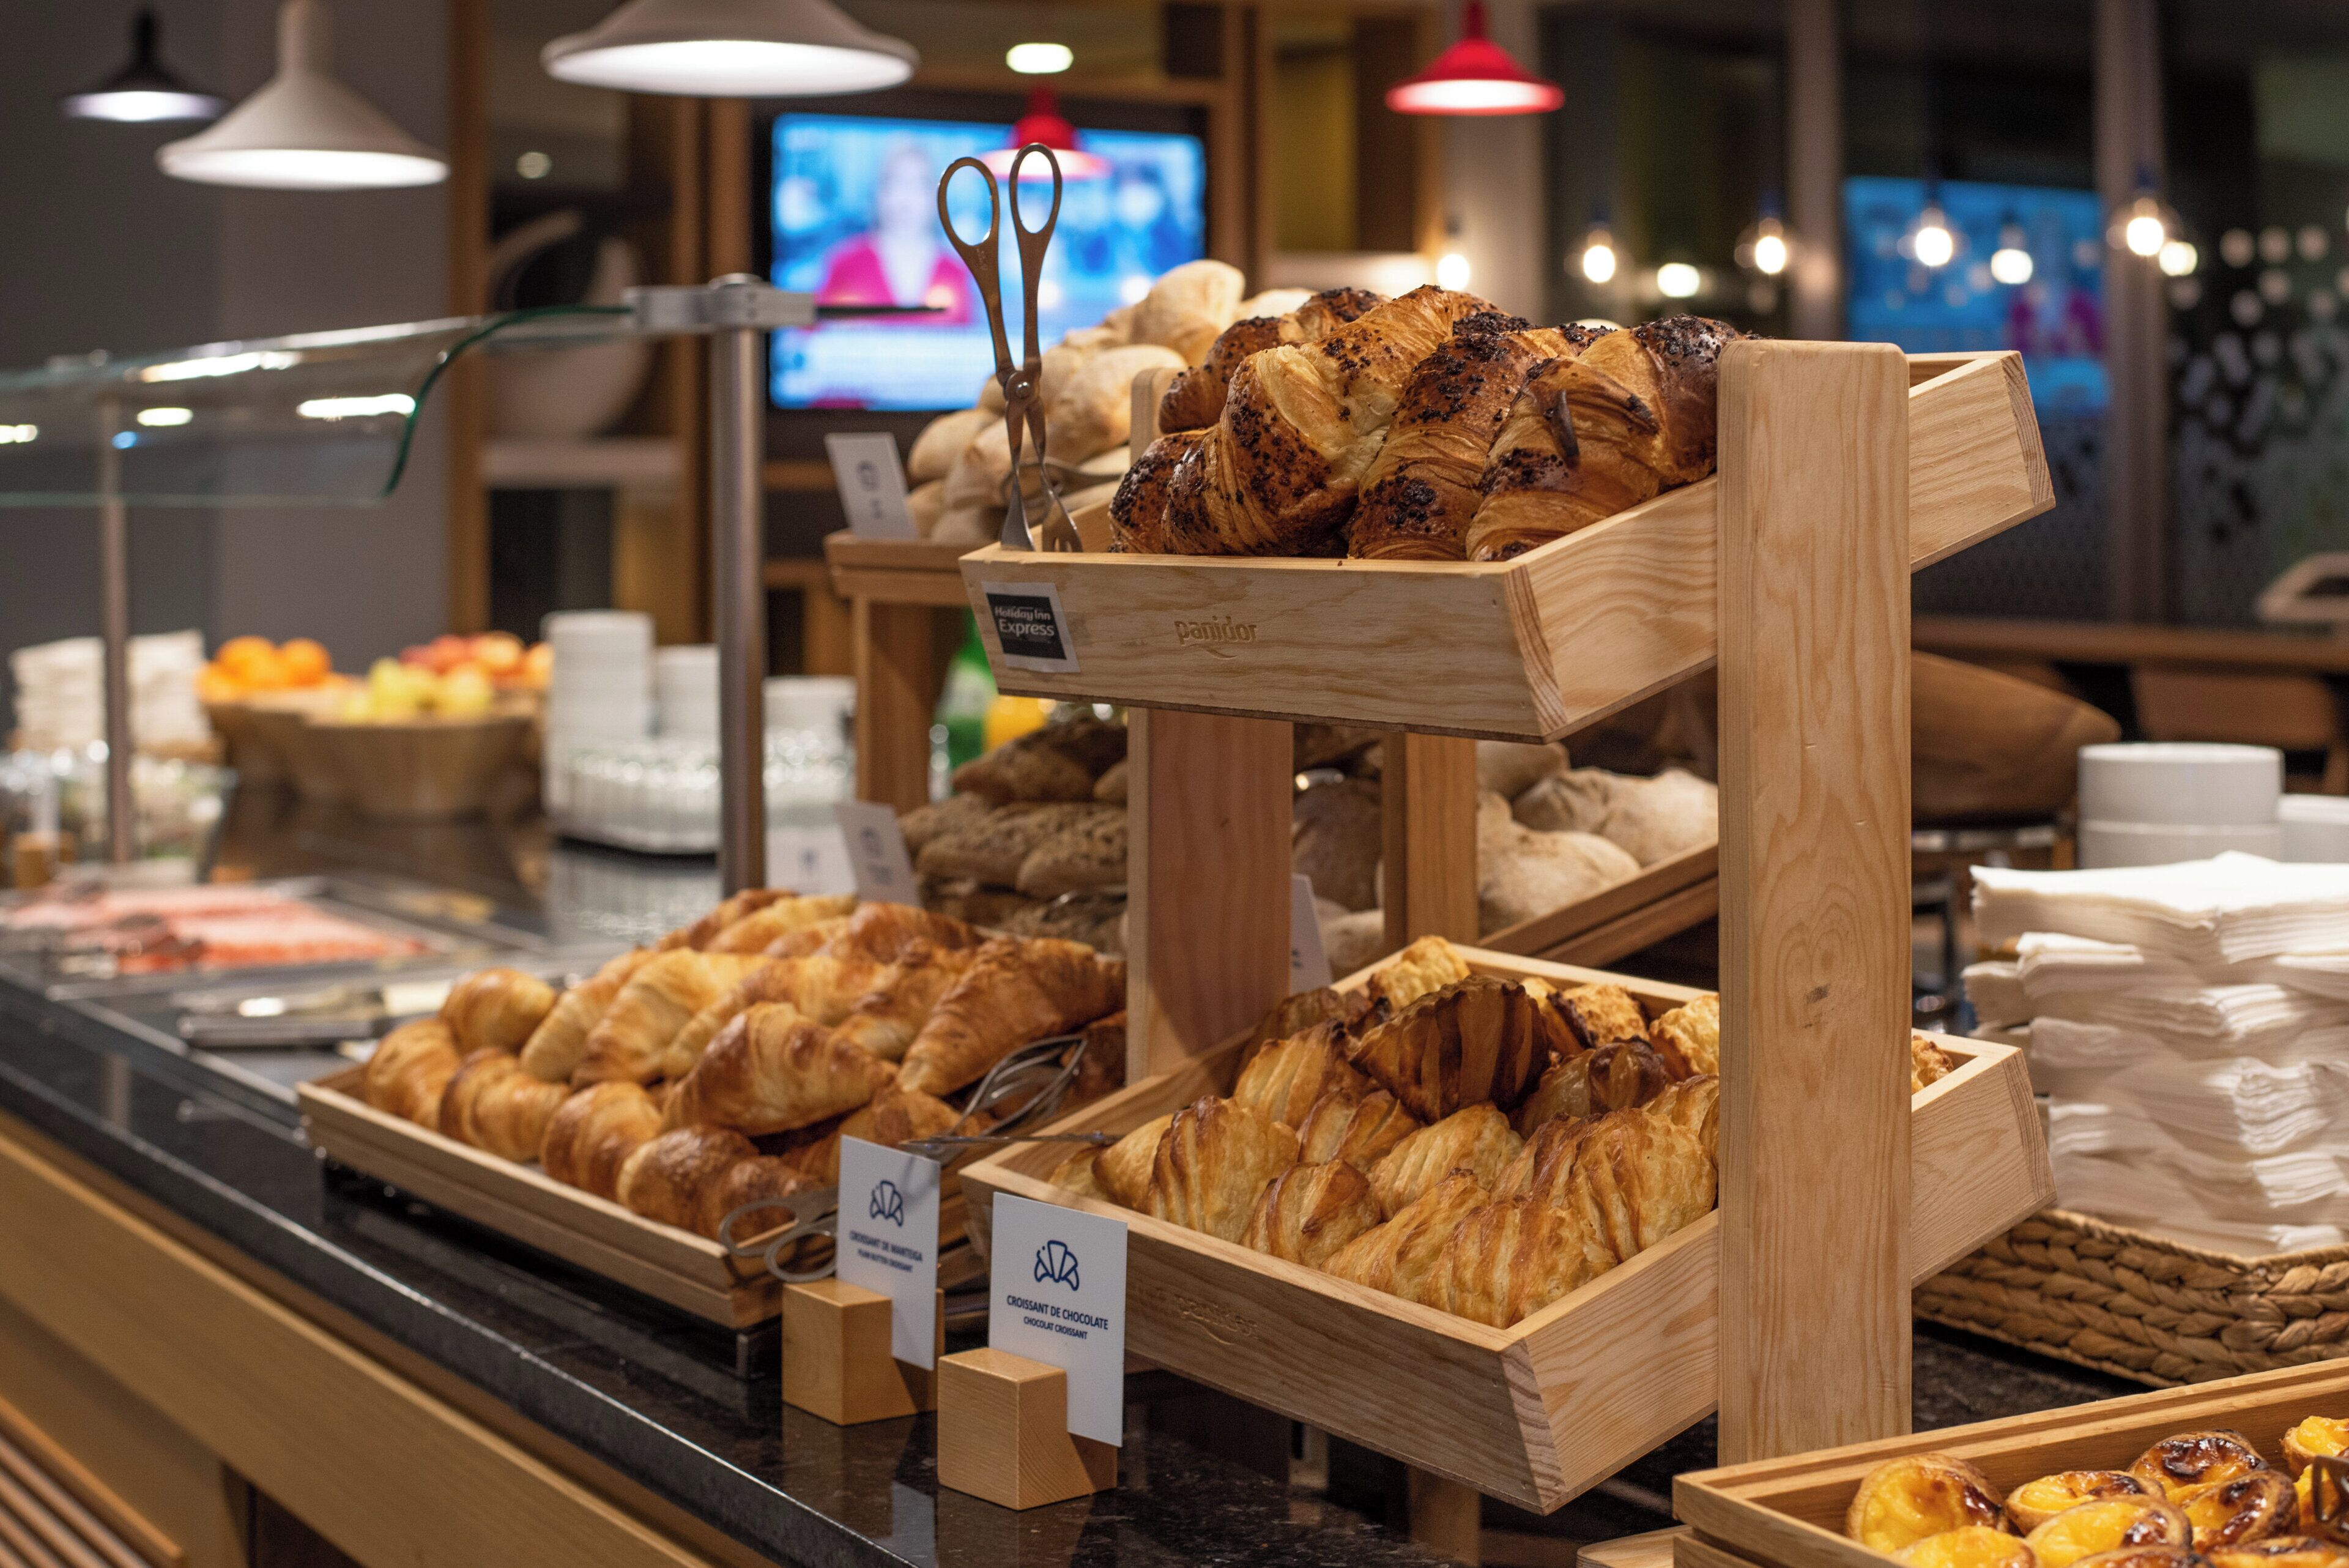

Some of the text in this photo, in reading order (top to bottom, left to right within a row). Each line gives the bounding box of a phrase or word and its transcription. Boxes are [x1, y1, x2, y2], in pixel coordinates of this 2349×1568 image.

[995, 606, 1051, 622] Holiday Inn
[999, 619, 1055, 637] Express
[1174, 615, 1257, 647] panidor
[1007, 1295, 1108, 1330] CROISSANT DE CHOCOLATE
[1023, 1316, 1088, 1340] CHOCOLAT CROISSANT
